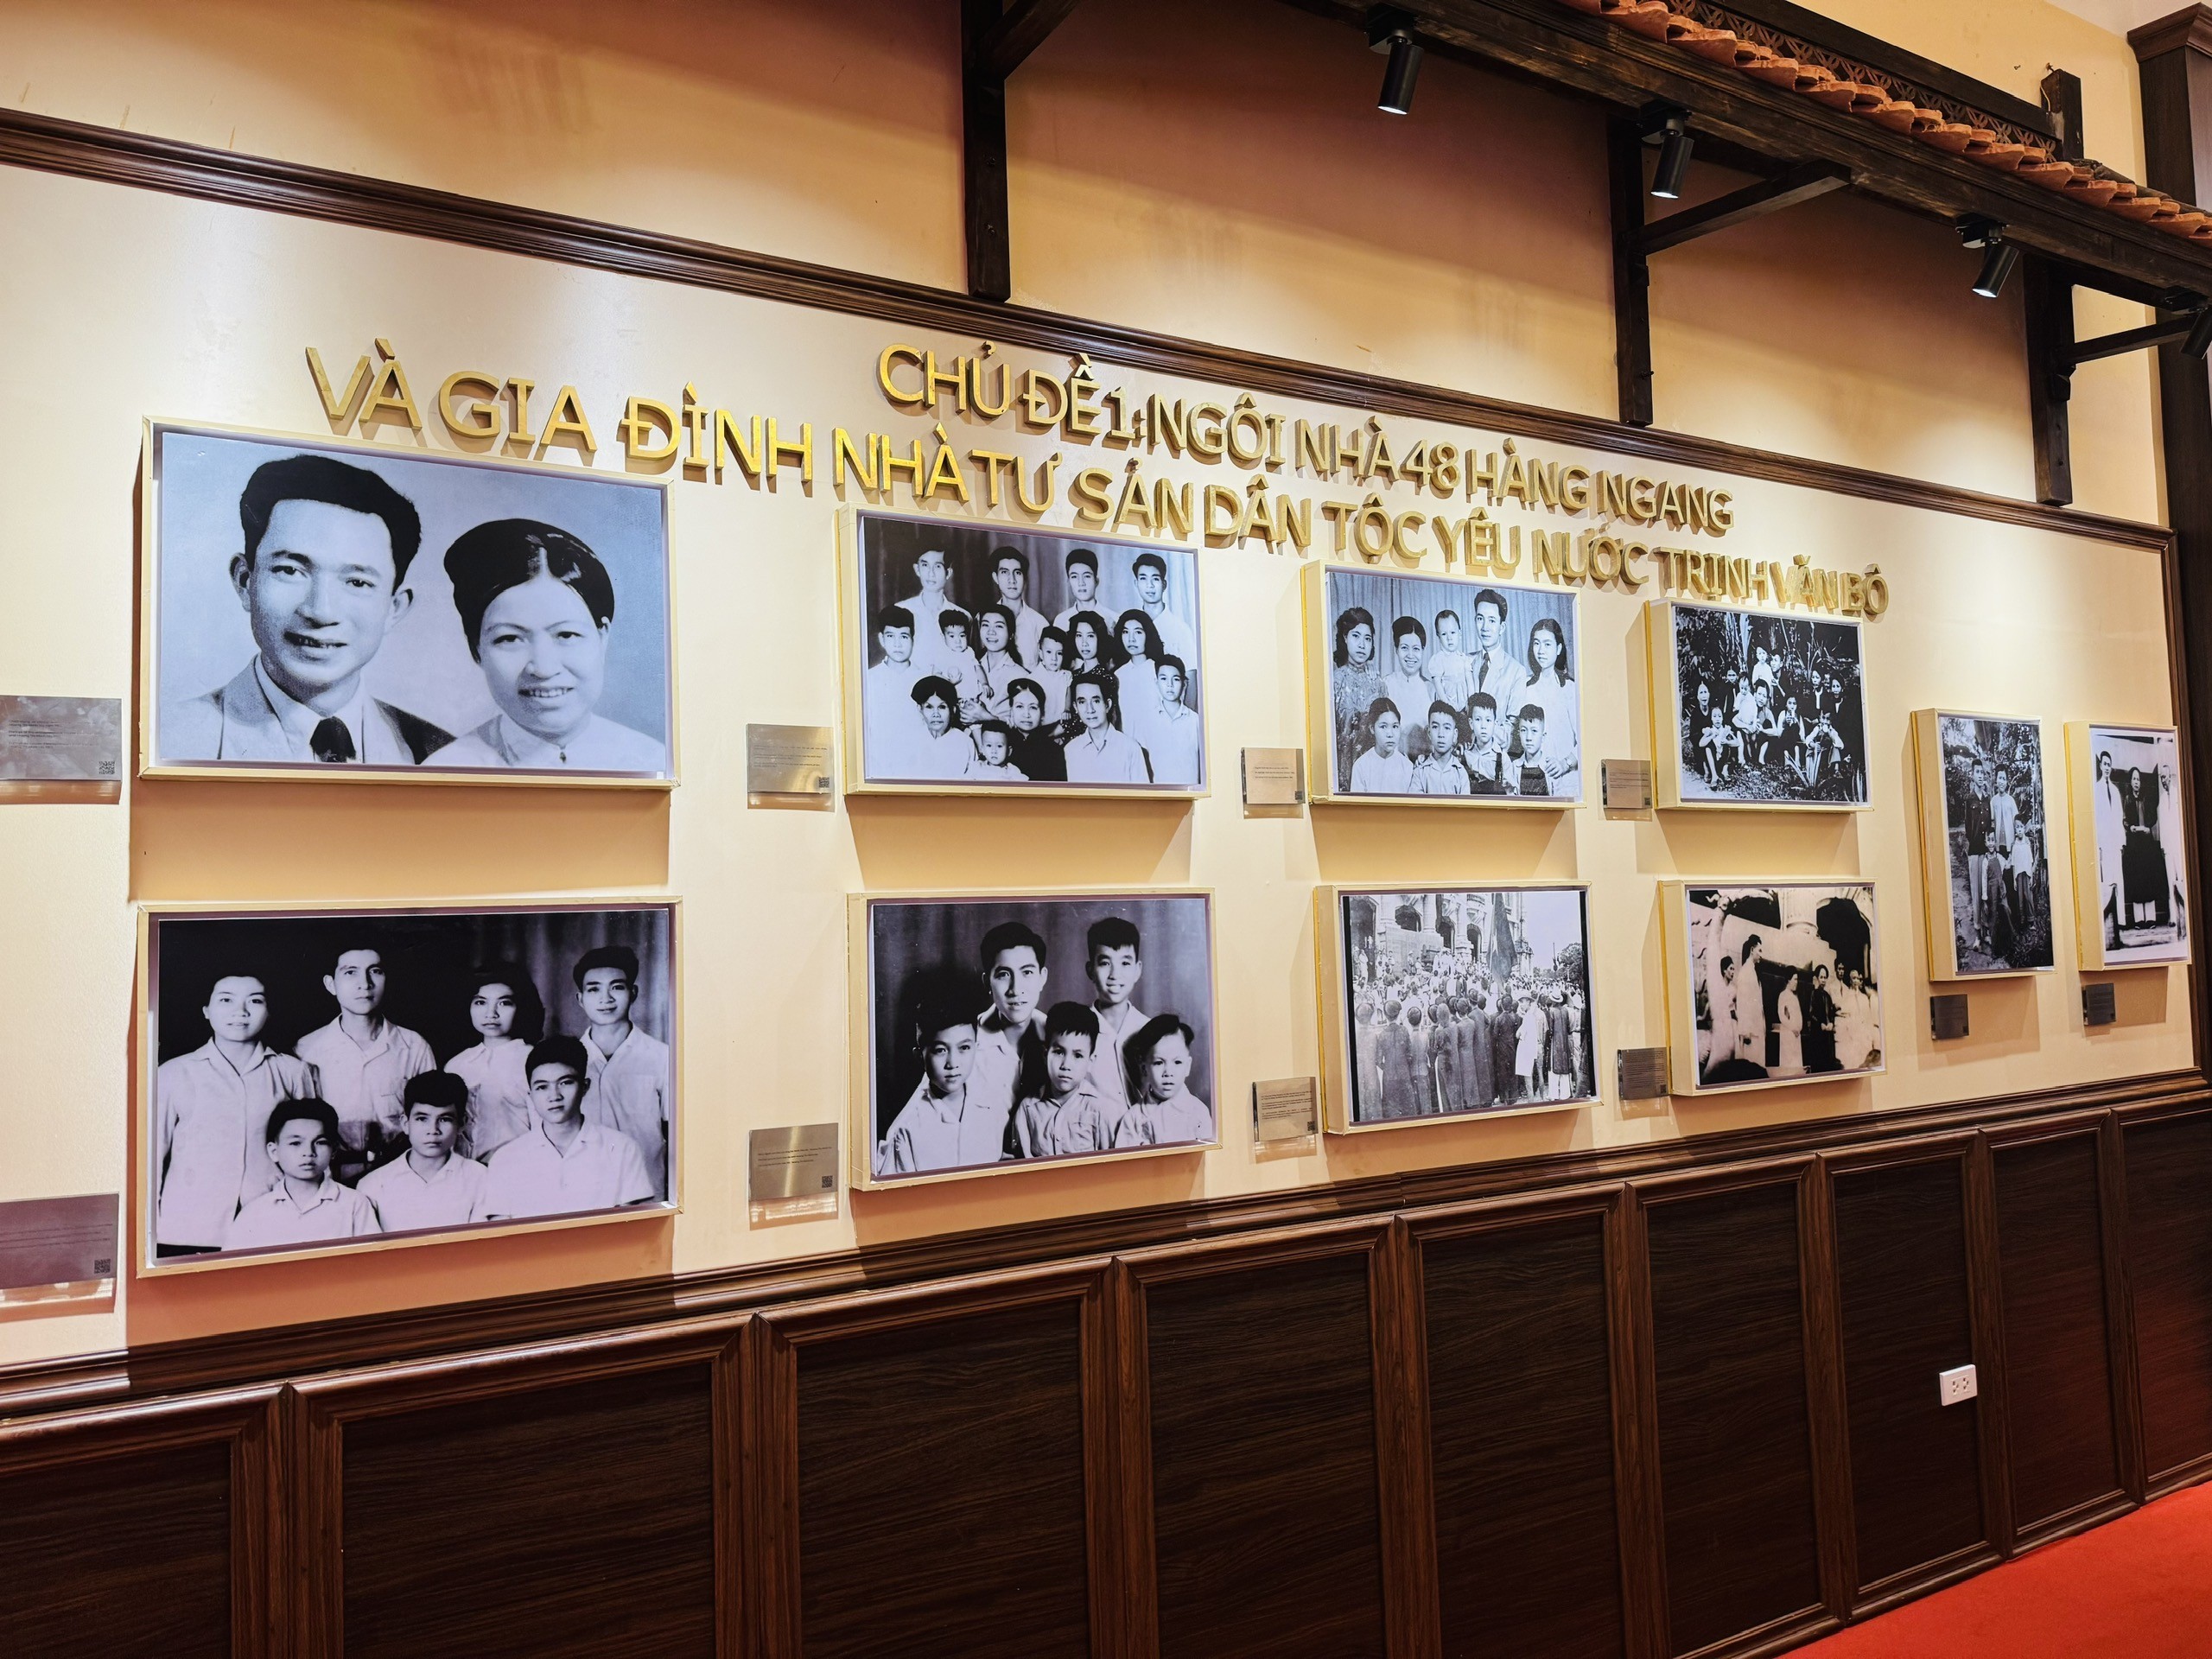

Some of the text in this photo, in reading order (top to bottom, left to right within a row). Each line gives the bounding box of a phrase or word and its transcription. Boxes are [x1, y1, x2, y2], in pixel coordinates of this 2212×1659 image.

[305, 338, 1890, 615] VÀ GIA ĐÌNH NHÀ TƯ SẢN DÂN TỘC YÊU NƯỚC TRỊNH VĂN BÔ
[877, 340, 1010, 418] CHỦ
[1019, 353, 1102, 435] ĐỀ
[1147, 391, 1287, 465] NGÔI
[1295, 416, 1401, 482] NHÀ
[1401, 439, 1462, 491] 48
[1465, 437, 1591, 508] HÀNG
[1596, 470, 1735, 531] NGANG
